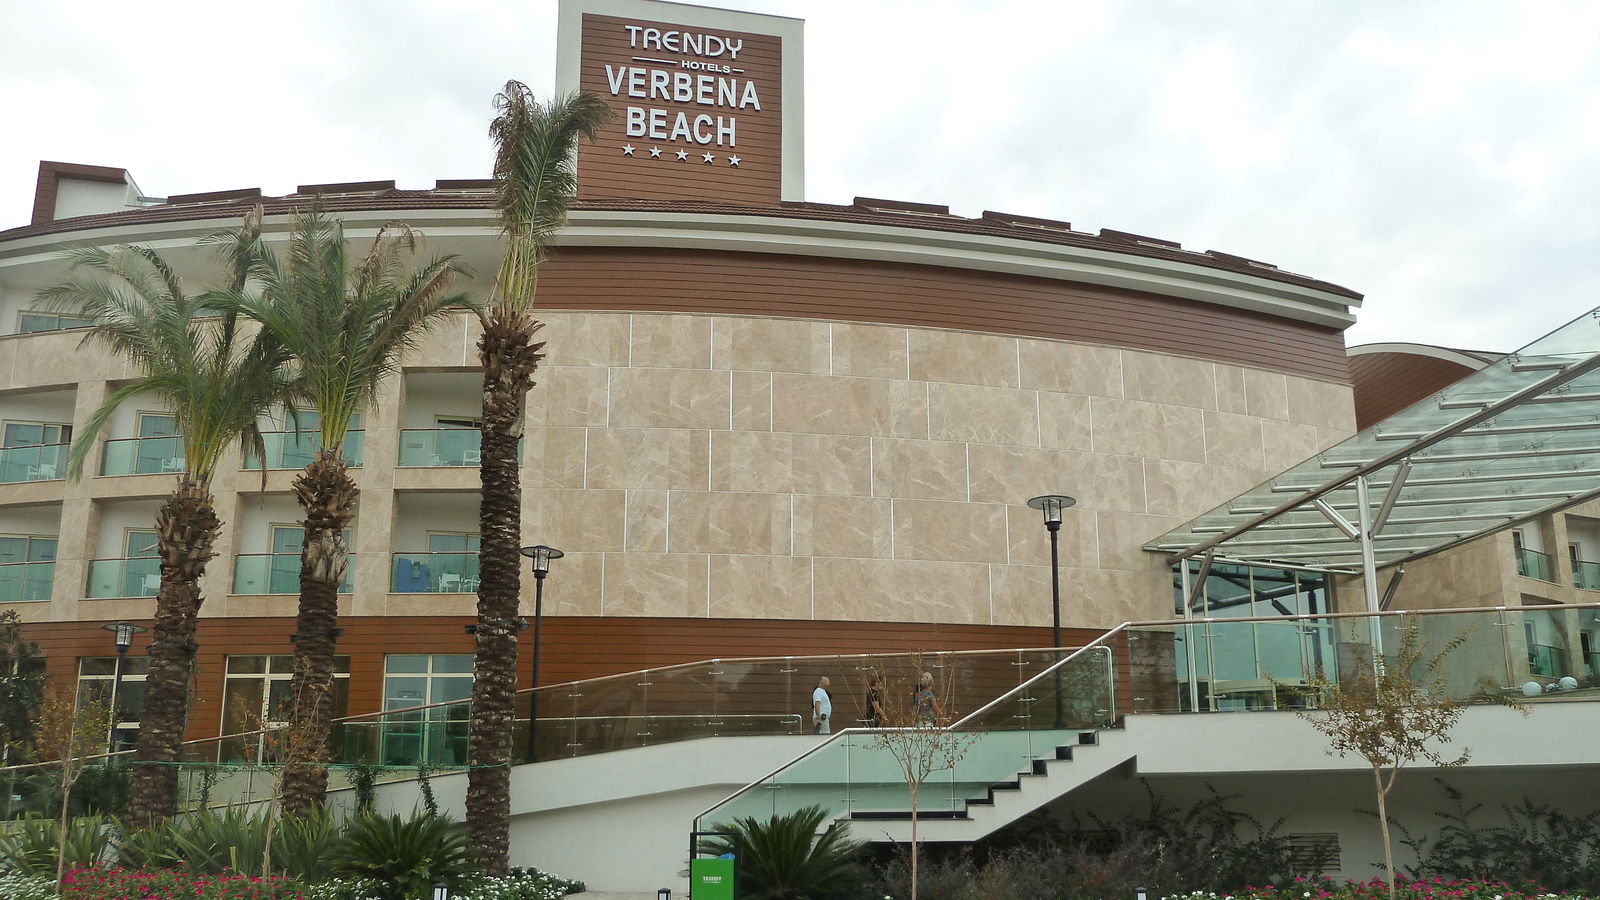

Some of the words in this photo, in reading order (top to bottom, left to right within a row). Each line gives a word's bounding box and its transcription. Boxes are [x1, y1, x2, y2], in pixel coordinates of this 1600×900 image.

[625, 25, 743, 59] TRENDY
[681, 60, 731, 73] HOTELS
[605, 64, 761, 111] VERBENA
[626, 106, 736, 147] BEACH
